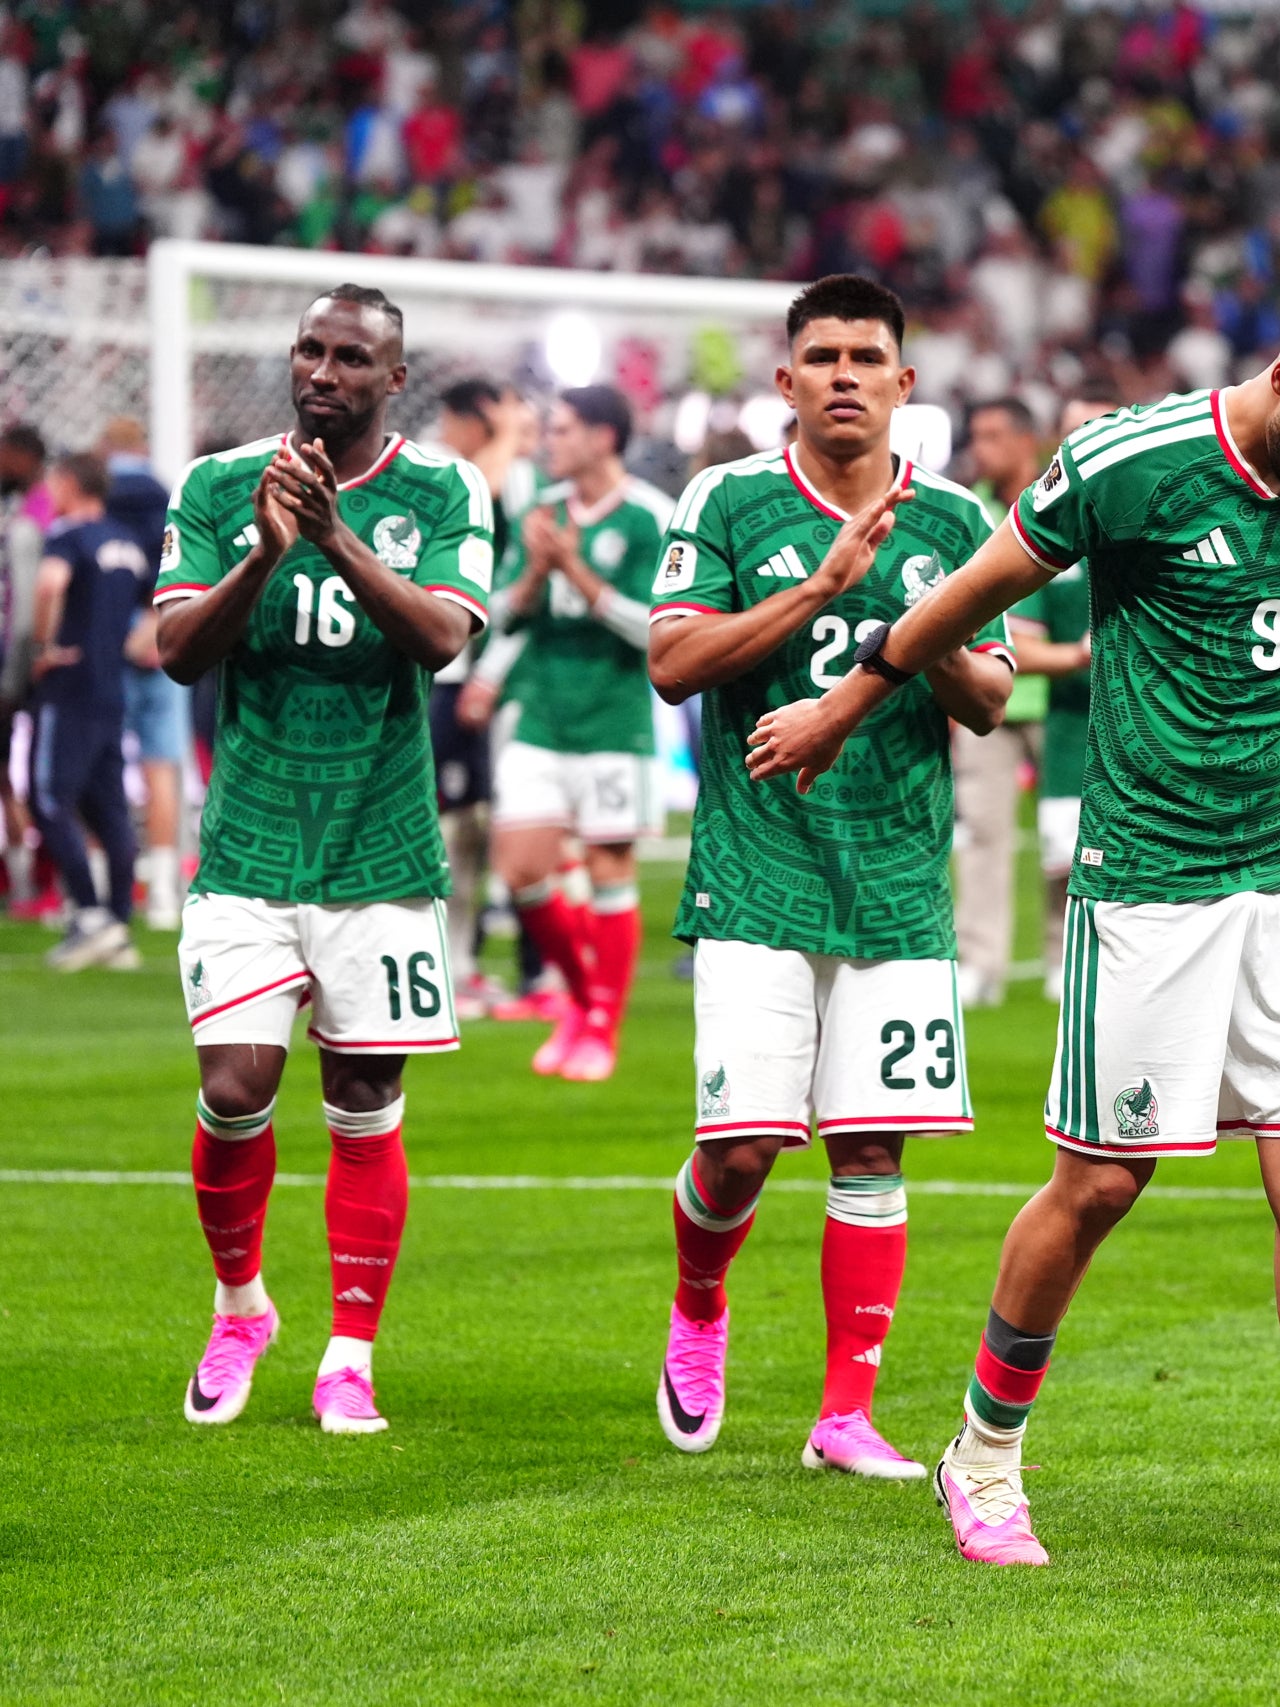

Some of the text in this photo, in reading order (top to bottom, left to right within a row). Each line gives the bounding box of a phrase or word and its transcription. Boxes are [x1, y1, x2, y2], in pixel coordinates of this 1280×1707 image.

[293, 573, 357, 647] 16
[381, 951, 441, 1021] 16
[880, 1018, 956, 1090] 23
[1120, 1126, 1157, 1136] MÉXICO
